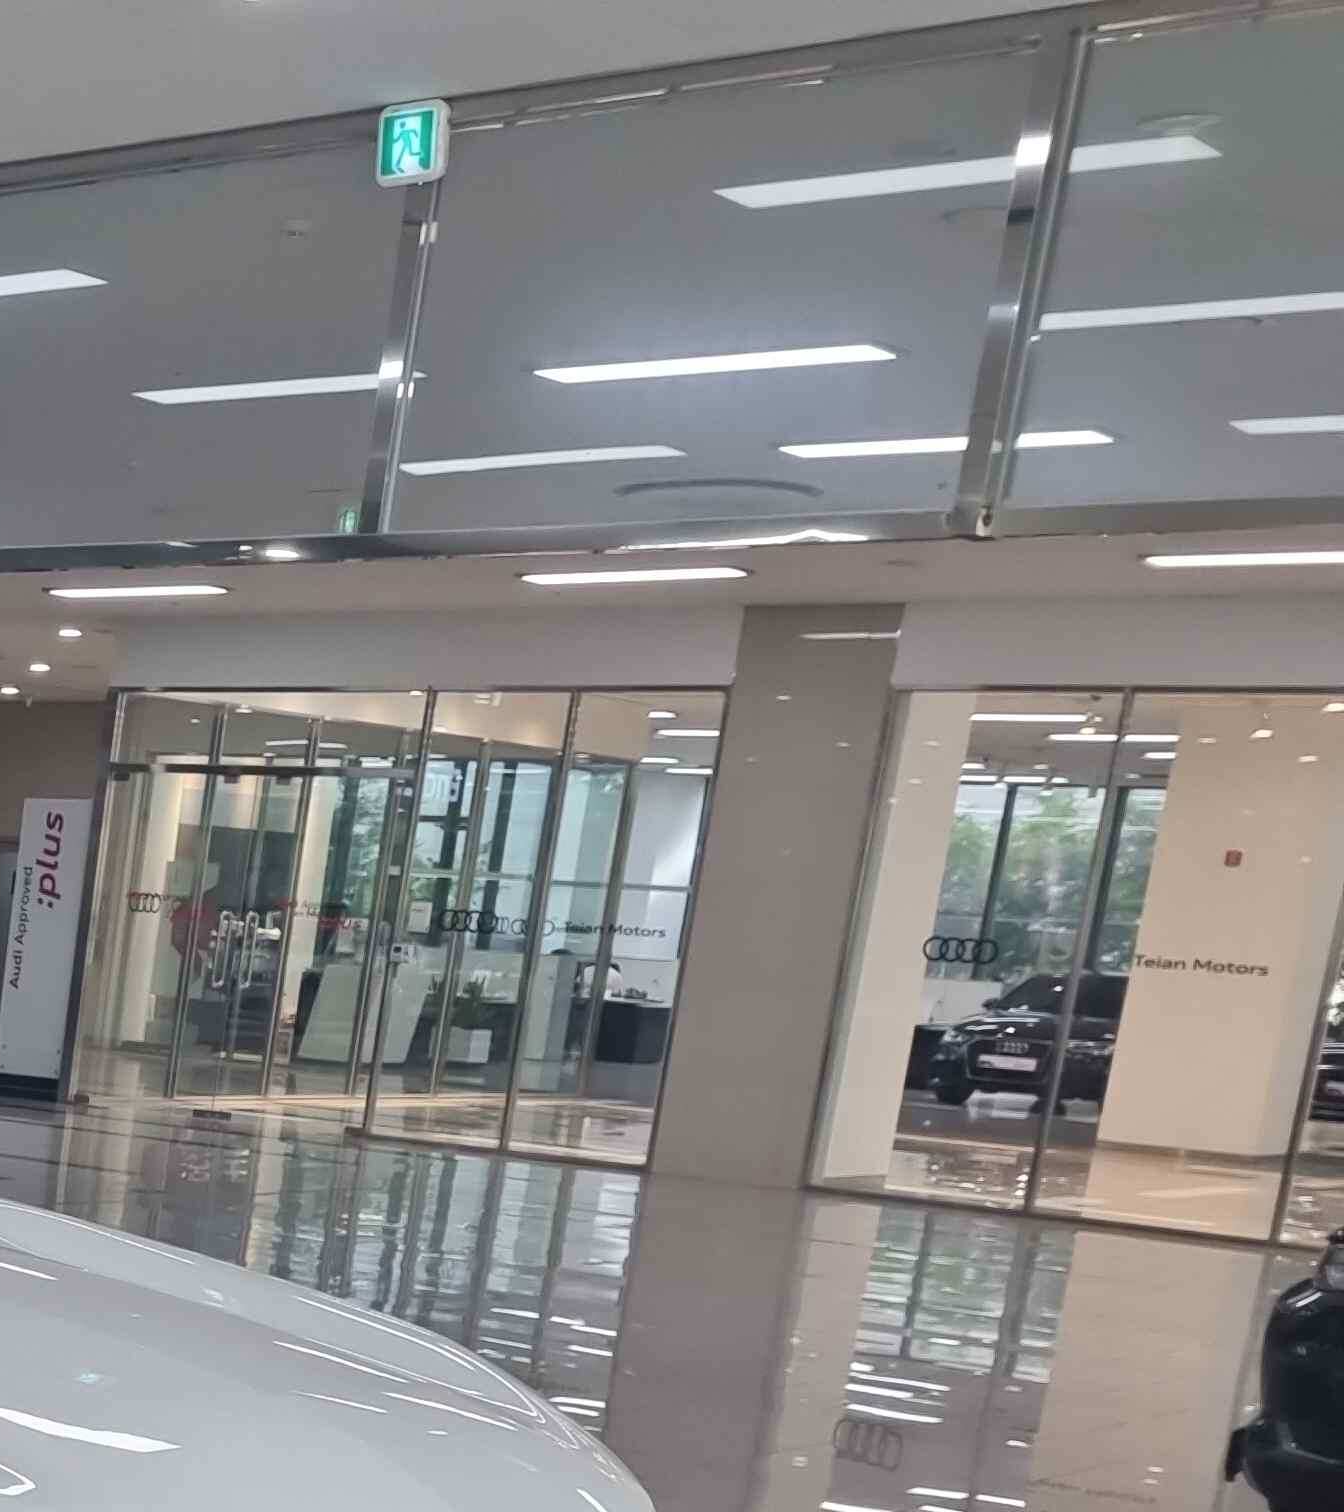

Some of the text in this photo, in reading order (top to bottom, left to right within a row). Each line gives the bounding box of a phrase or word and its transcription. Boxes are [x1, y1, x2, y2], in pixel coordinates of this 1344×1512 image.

[9, 866, 33, 989] Audi Approved
[1135, 954, 1269, 977] Teian Motors
